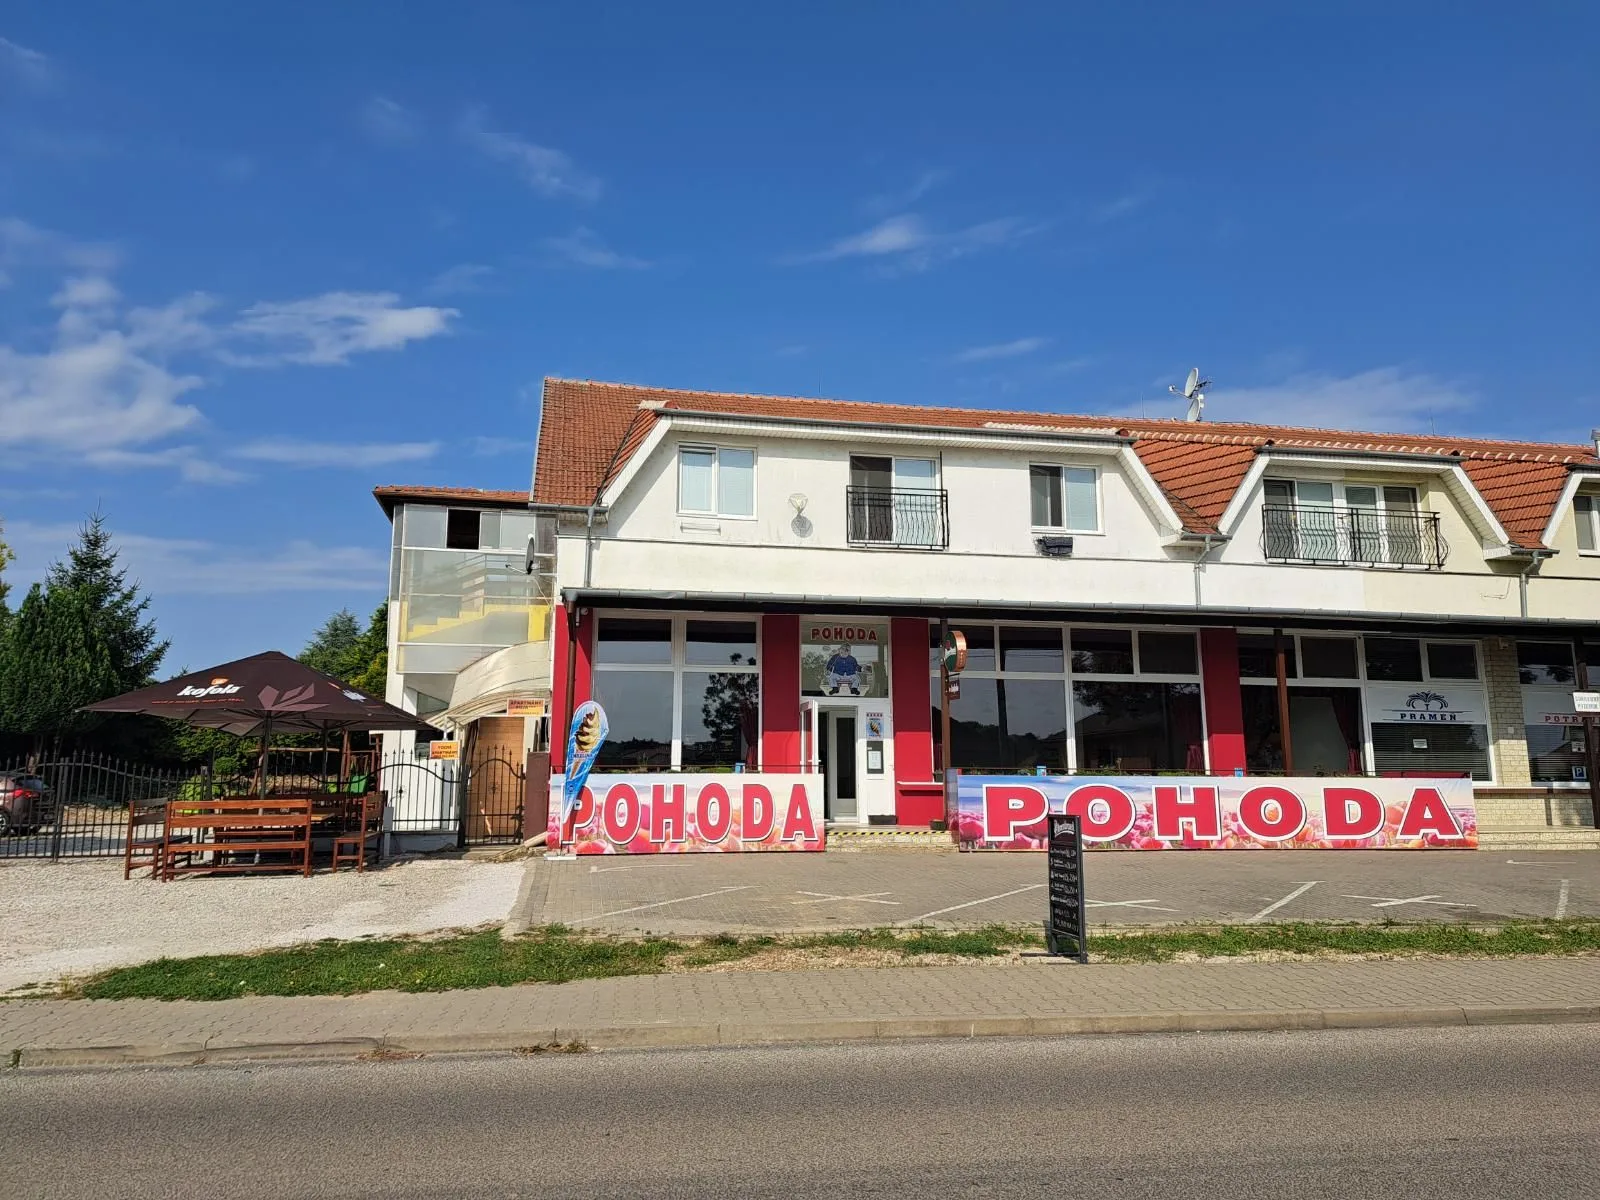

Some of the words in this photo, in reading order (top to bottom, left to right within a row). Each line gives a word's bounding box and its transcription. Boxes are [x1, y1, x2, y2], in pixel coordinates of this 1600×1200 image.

[811, 627, 877, 640] POHODA
[177, 684, 244, 698] kofola
[1400, 713, 1456, 721] PRAMEN
[560, 782, 818, 844] POHODA
[982, 783, 1464, 842] POHODA
